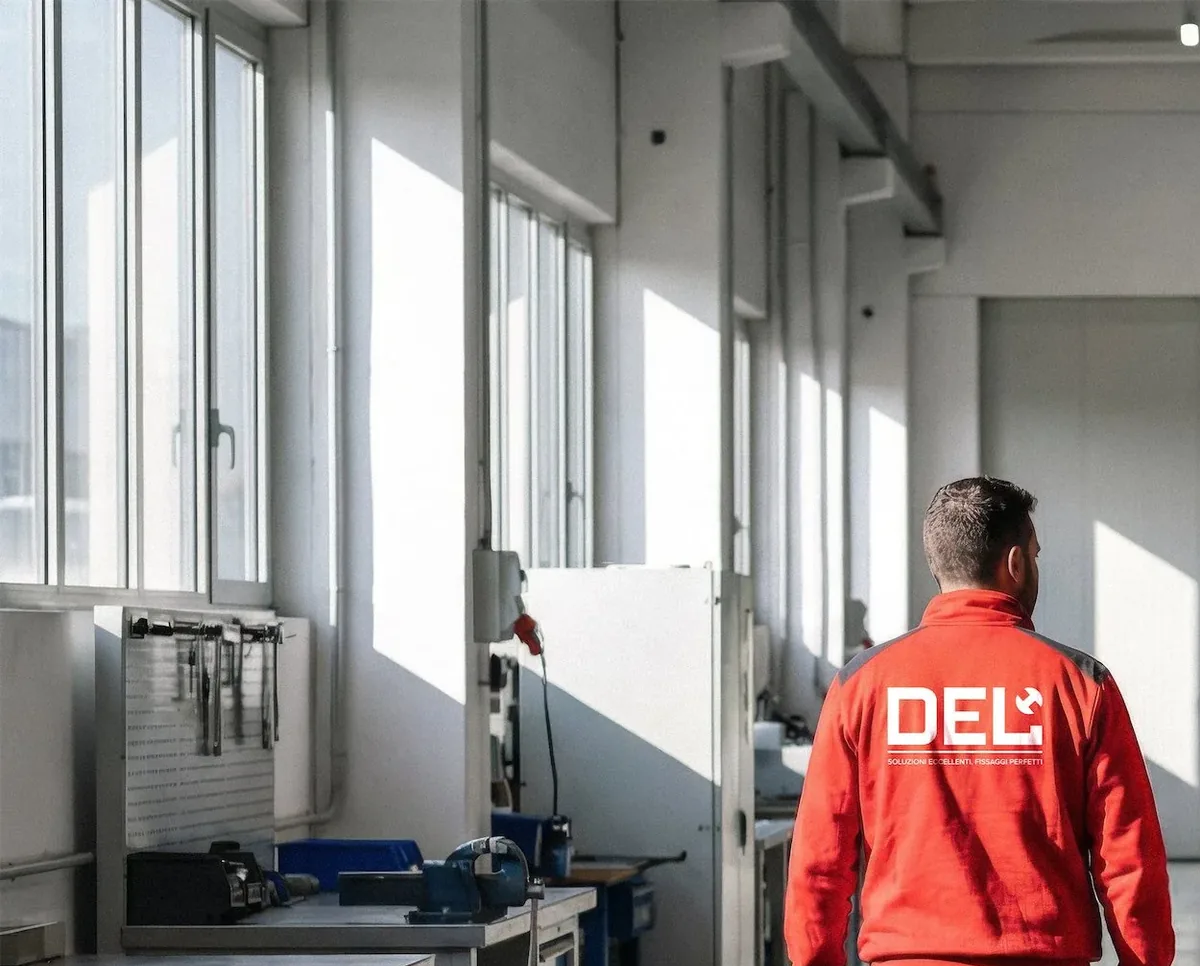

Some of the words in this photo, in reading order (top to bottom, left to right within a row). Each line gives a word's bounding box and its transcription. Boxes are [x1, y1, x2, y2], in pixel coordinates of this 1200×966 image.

[887, 687, 1043, 745] DEL
[888, 758, 927, 766] SOLUZIONI
[975, 758, 1008, 766] FISSAGGI
[1009, 758, 1043, 766] PERFETTI
